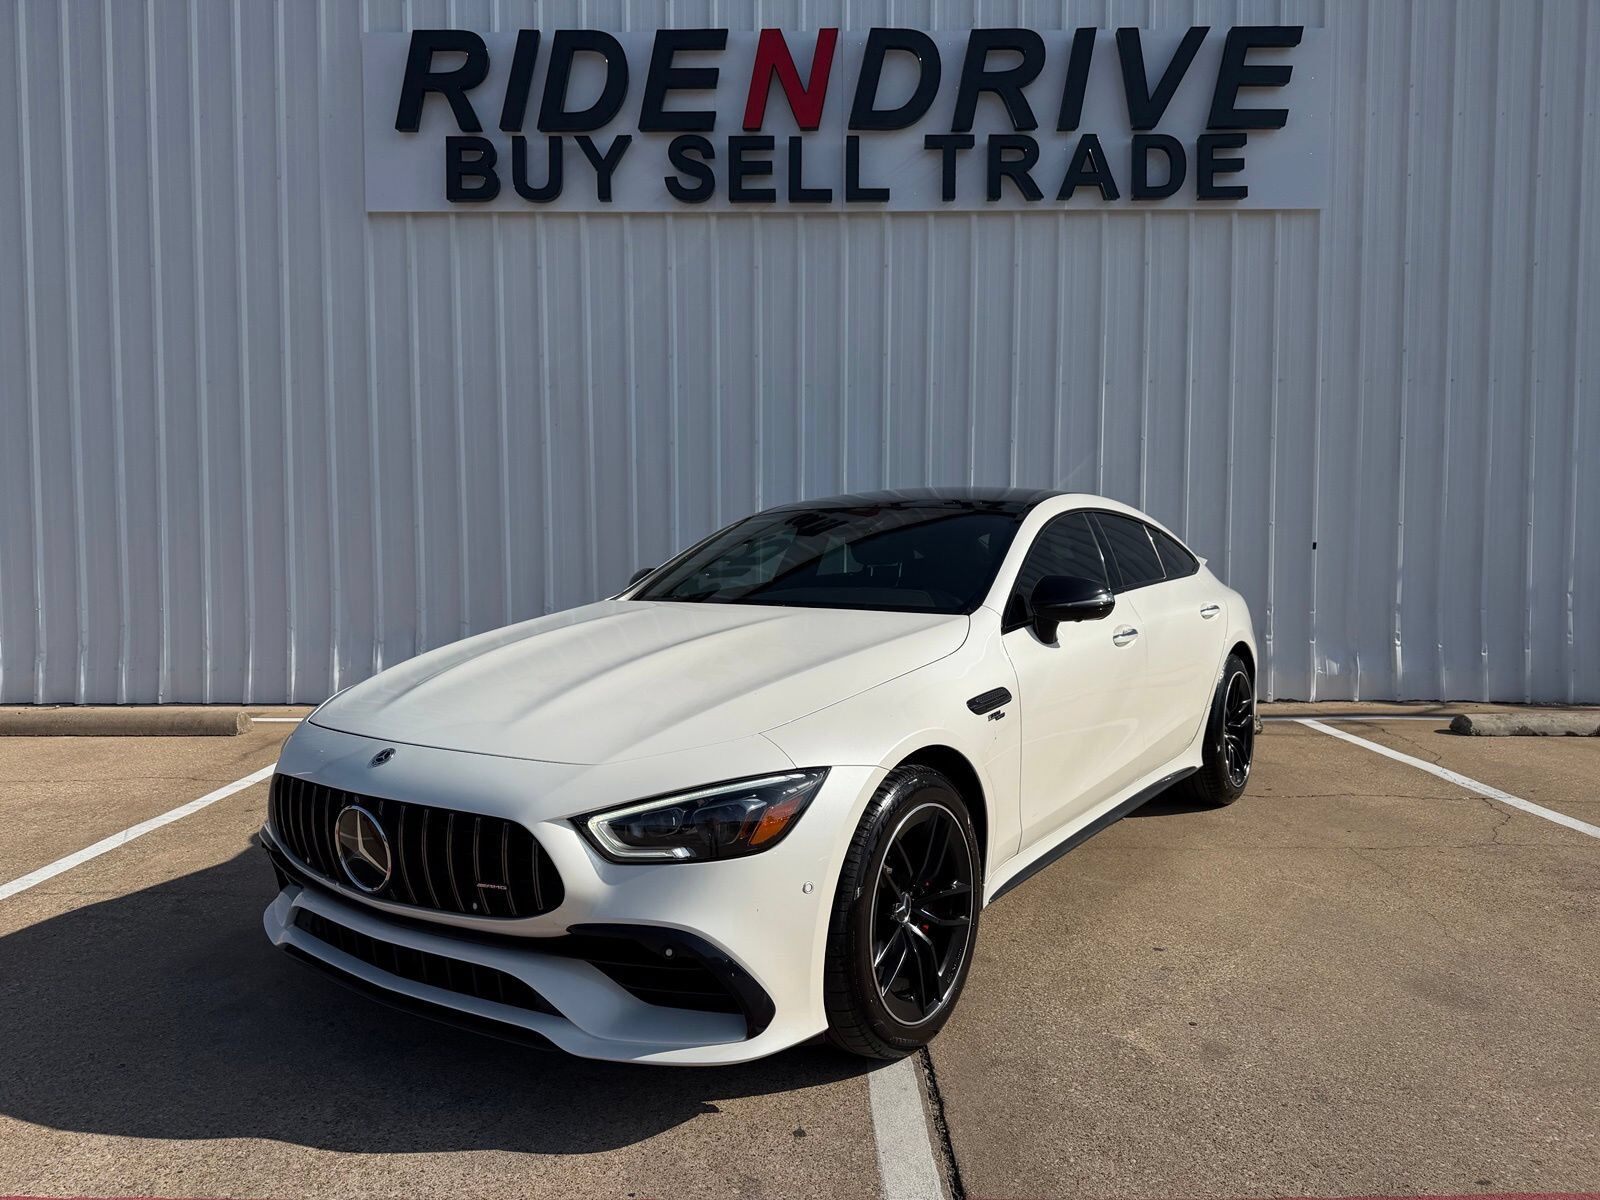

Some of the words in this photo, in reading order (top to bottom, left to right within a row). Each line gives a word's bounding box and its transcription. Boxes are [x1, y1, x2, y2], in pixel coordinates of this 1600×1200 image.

[395, 26, 1304, 132] RIDENDRIVE
[445, 135, 632, 202] BUY
[664, 135, 890, 203] SELL
[924, 133, 1248, 201] TRADE
